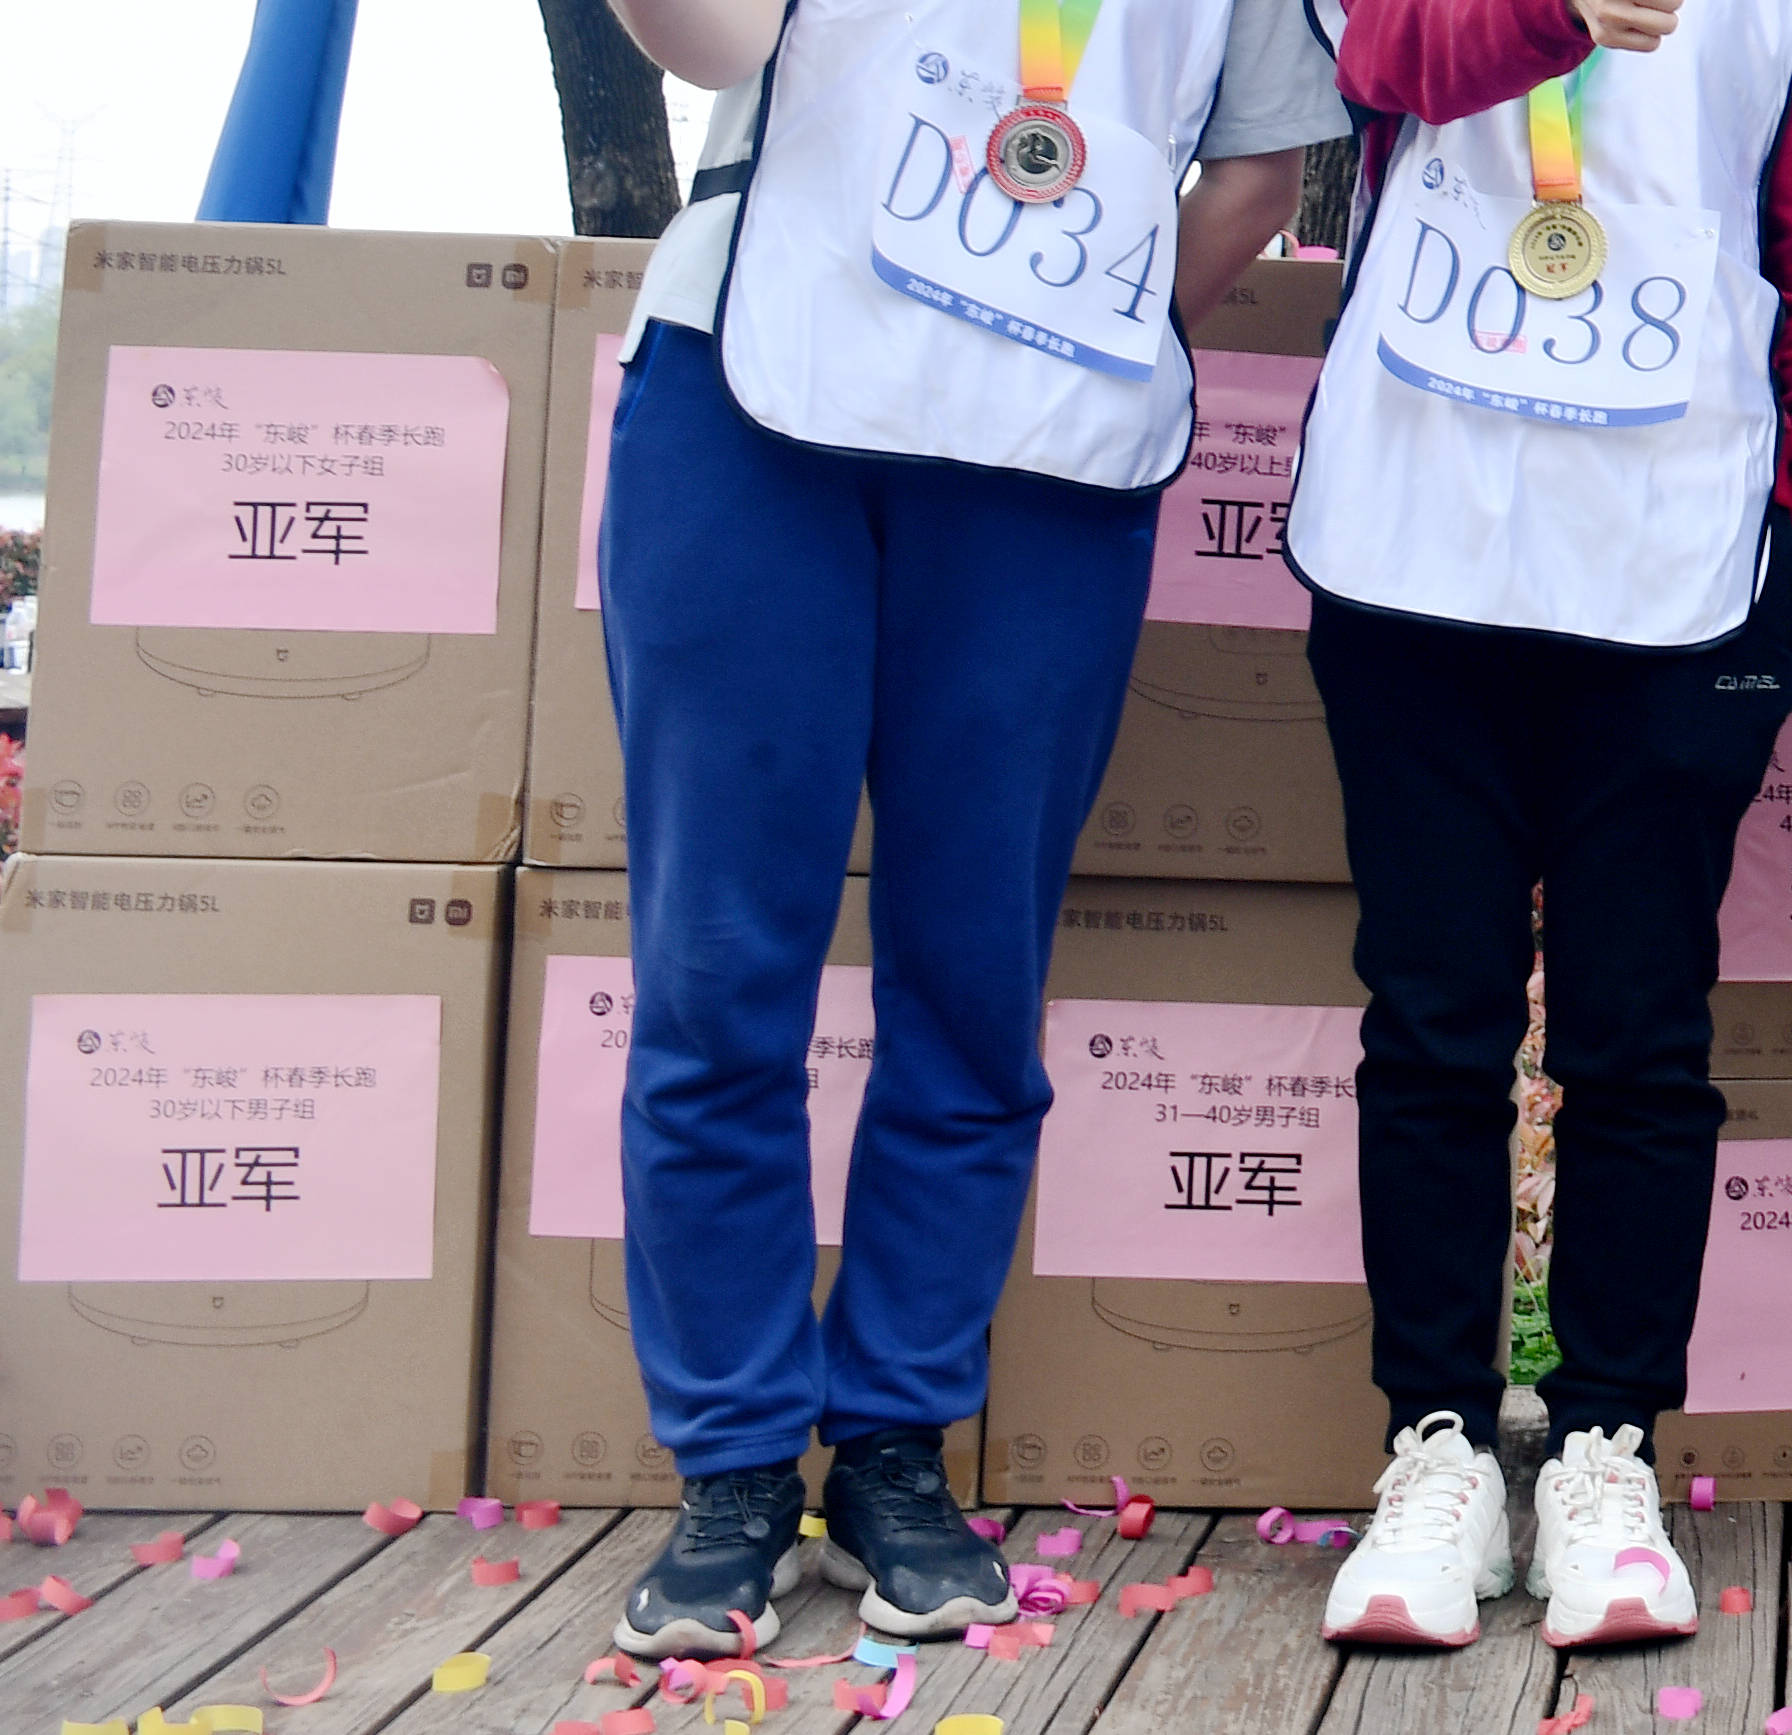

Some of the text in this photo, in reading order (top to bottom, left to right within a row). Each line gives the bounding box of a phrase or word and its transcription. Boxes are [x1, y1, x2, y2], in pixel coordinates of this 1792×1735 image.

[881, 111, 1160, 325] D034
[1397, 217, 1689, 373] D038
[221, 452, 386, 478] 30岁以下女子组
[227, 500, 370, 566] 亚军
[1194, 497, 1291, 561] 亚
[1057, 908, 1229, 933] 家智能电压力锅5L
[148, 1097, 317, 1123] 30岁以下男子组
[156, 1145, 301, 1213] 亚军
[1164, 1151, 1303, 1217] 亚军
